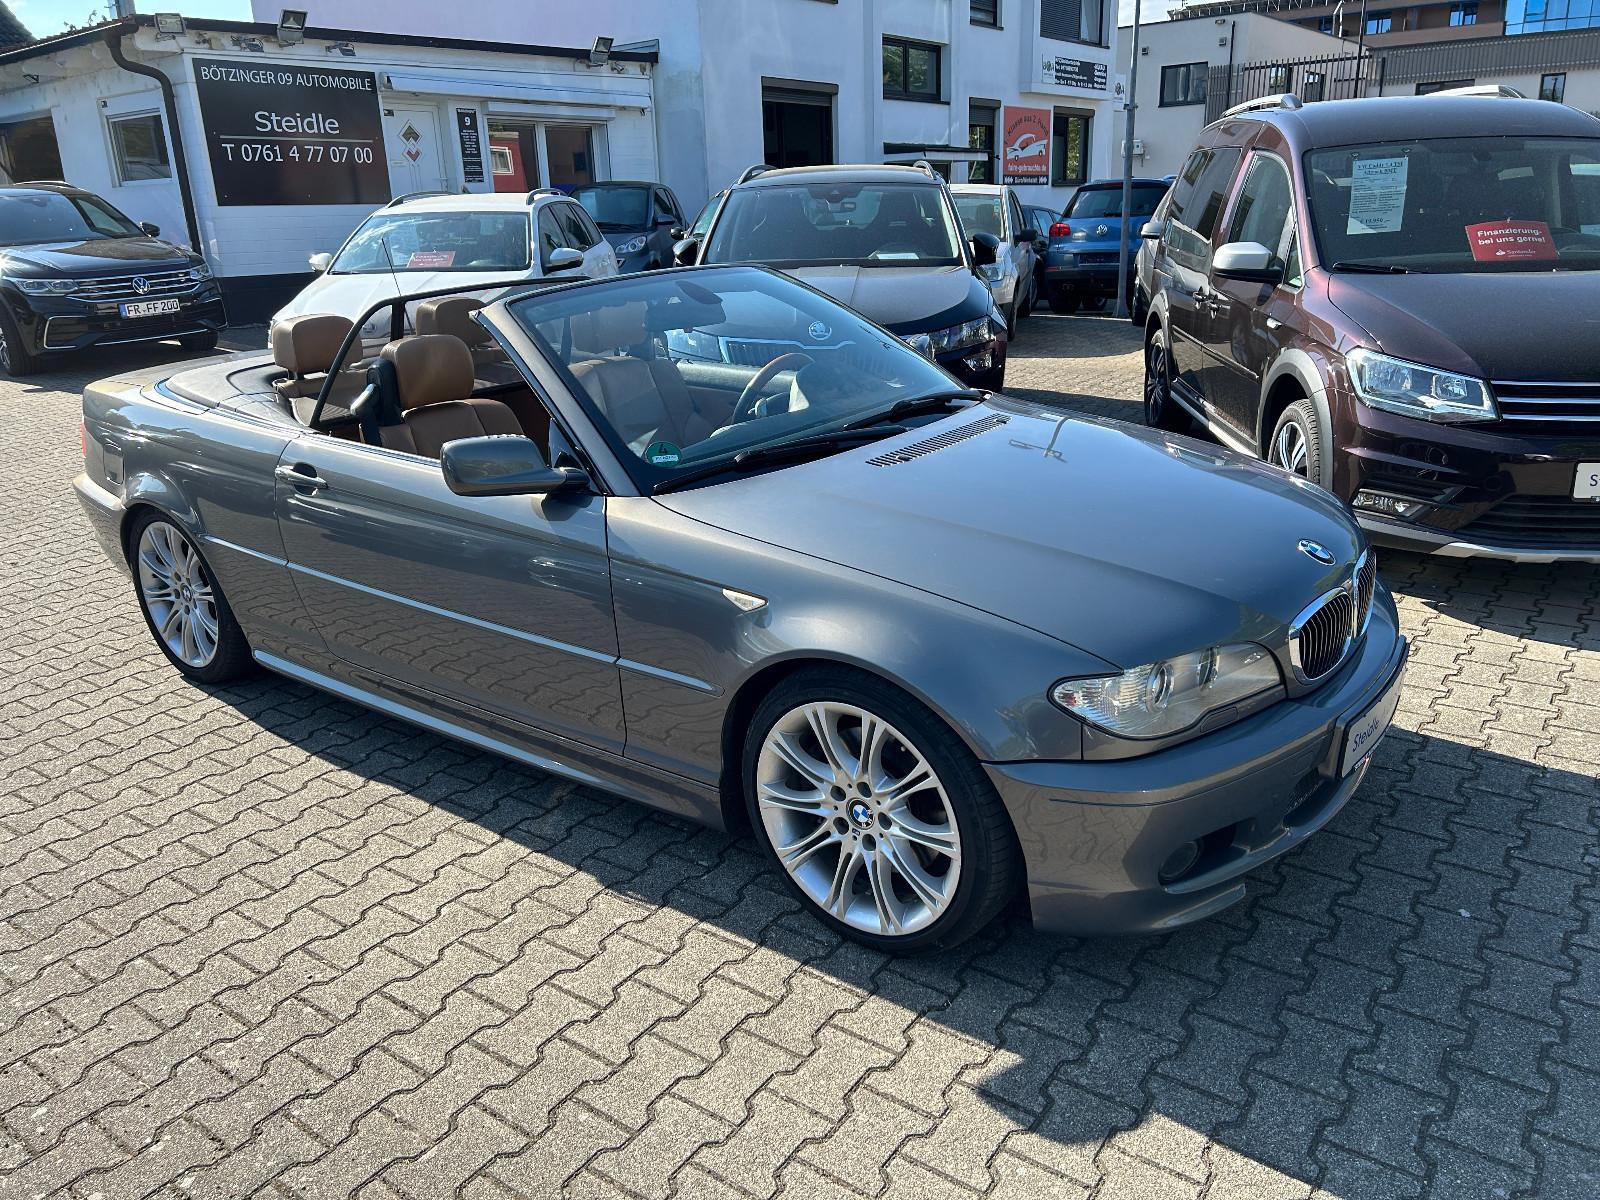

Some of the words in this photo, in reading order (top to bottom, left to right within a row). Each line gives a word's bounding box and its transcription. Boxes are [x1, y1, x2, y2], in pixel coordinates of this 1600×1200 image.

[201, 65, 275, 84] BÖTZINGER
[277, 73, 293, 85] 09
[296, 73, 372, 91] AUTOMOBILE
[254, 110, 340, 135] Steidle
[464, 116, 471, 126] 9
[222, 143, 235, 161] T
[241, 144, 284, 162] 0761
[289, 145, 300, 161] 4
[304, 145, 324, 162] 77
[330, 146, 349, 163] 07
[354, 147, 373, 163] 00
[1478, 237, 1494, 245] bei
[1496, 235, 1515, 243] uns
[127, 304, 142, 316] FR
[161, 300, 179, 312] 200
[1590, 474, 1600, 487] S
